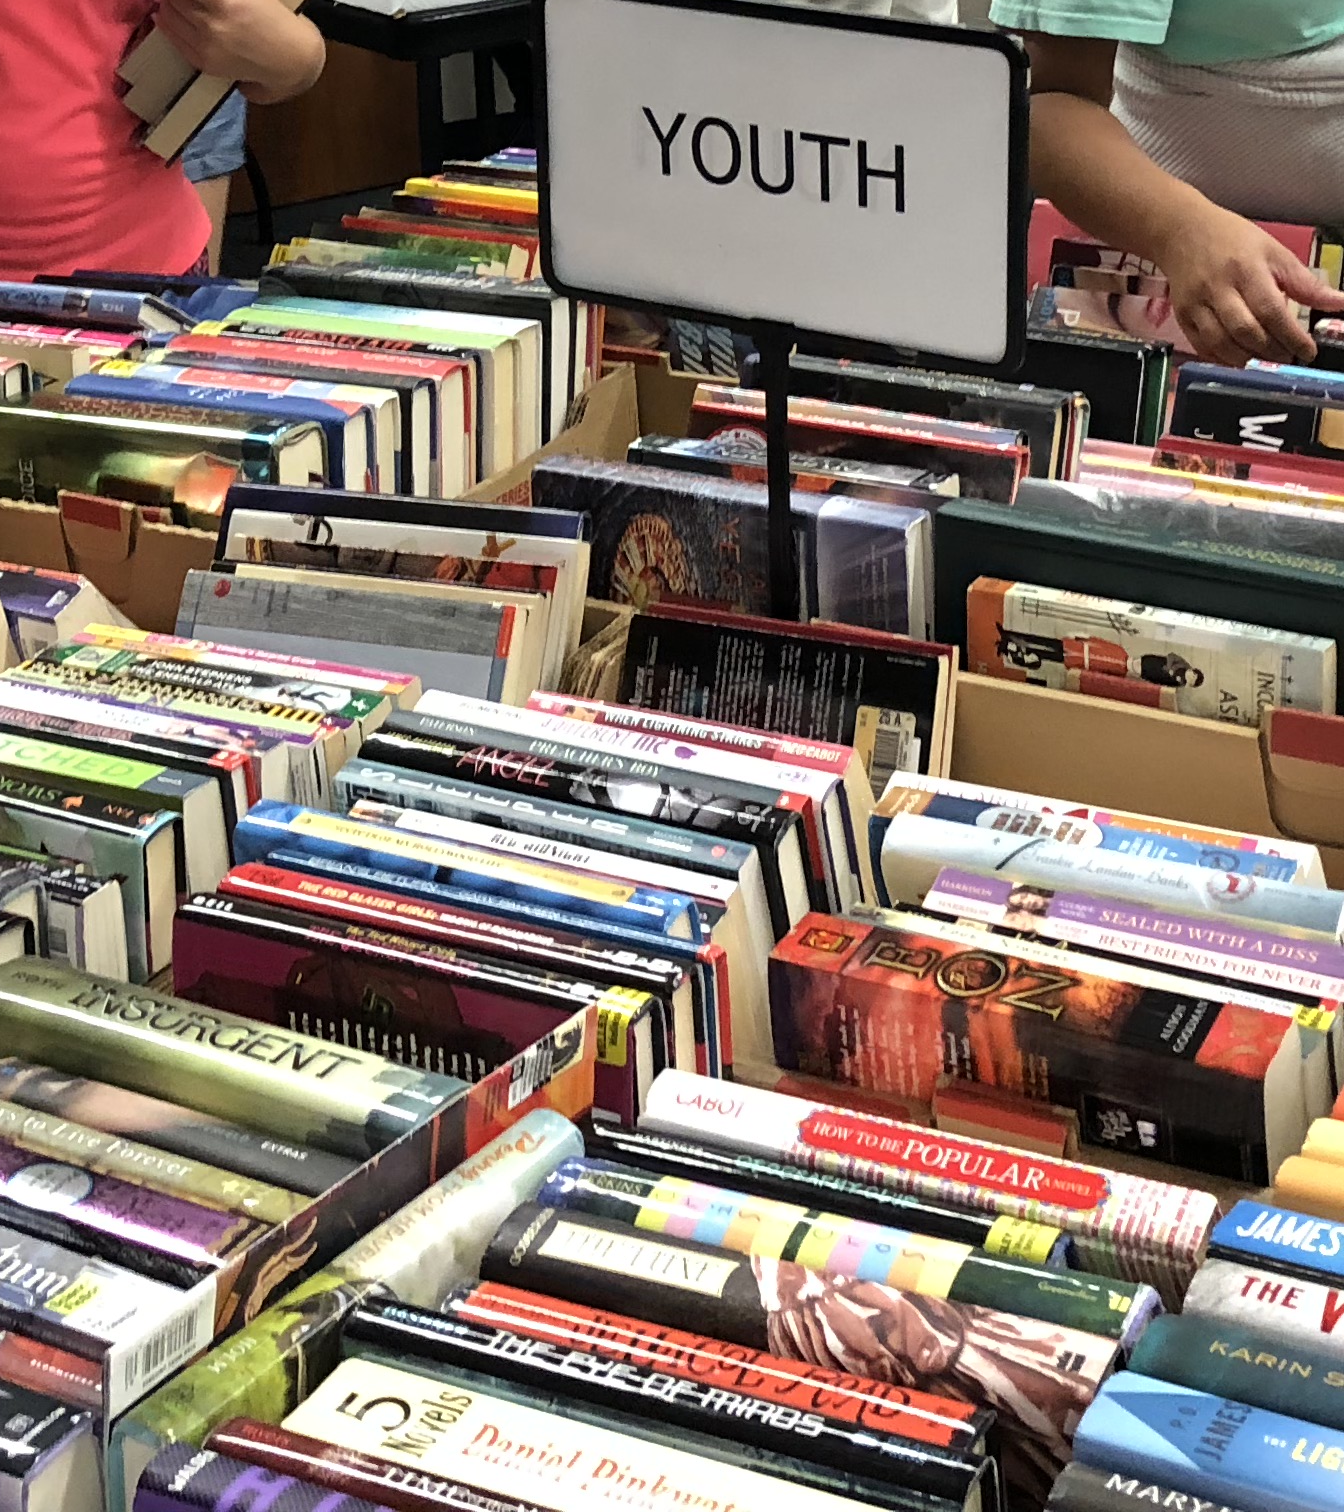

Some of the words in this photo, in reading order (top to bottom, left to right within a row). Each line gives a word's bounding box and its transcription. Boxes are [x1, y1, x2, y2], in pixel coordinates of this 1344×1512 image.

[642, 105, 906, 214] YOUTH
[1097, 933, 1144, 954] BEST
[1143, 942, 1219, 969] FRIENDS
[1221, 957, 1257, 978] FOR
[1260, 964, 1322, 992] NEVER
[1098, 909, 1183, 937] SEALED
[1187, 924, 1245, 951] WITH
[1246, 939, 1265, 953] A
[1268, 942, 1320, 965] DISS
[66, 984, 360, 1082] INSURGENT
[25, 1113, 46, 1136] to
[49, 1116, 101, 1151] Live
[103, 1139, 194, 1181] Forever
[811, 1119, 855, 1145] HOW
[855, 1128, 879, 1149] TO
[879, 1134, 904, 1154] BE
[900, 1137, 1049, 1194] POPULAR
[1055, 1179, 1093, 1198] NOVEL
[1235, 1209, 1343, 1258] JAMES
[1239, 1274, 1304, 1311] THE
[1207, 1338, 1315, 1380] KARIN
[335, 1388, 413, 1434] 5
[380, 1390, 474, 1459] Novels
